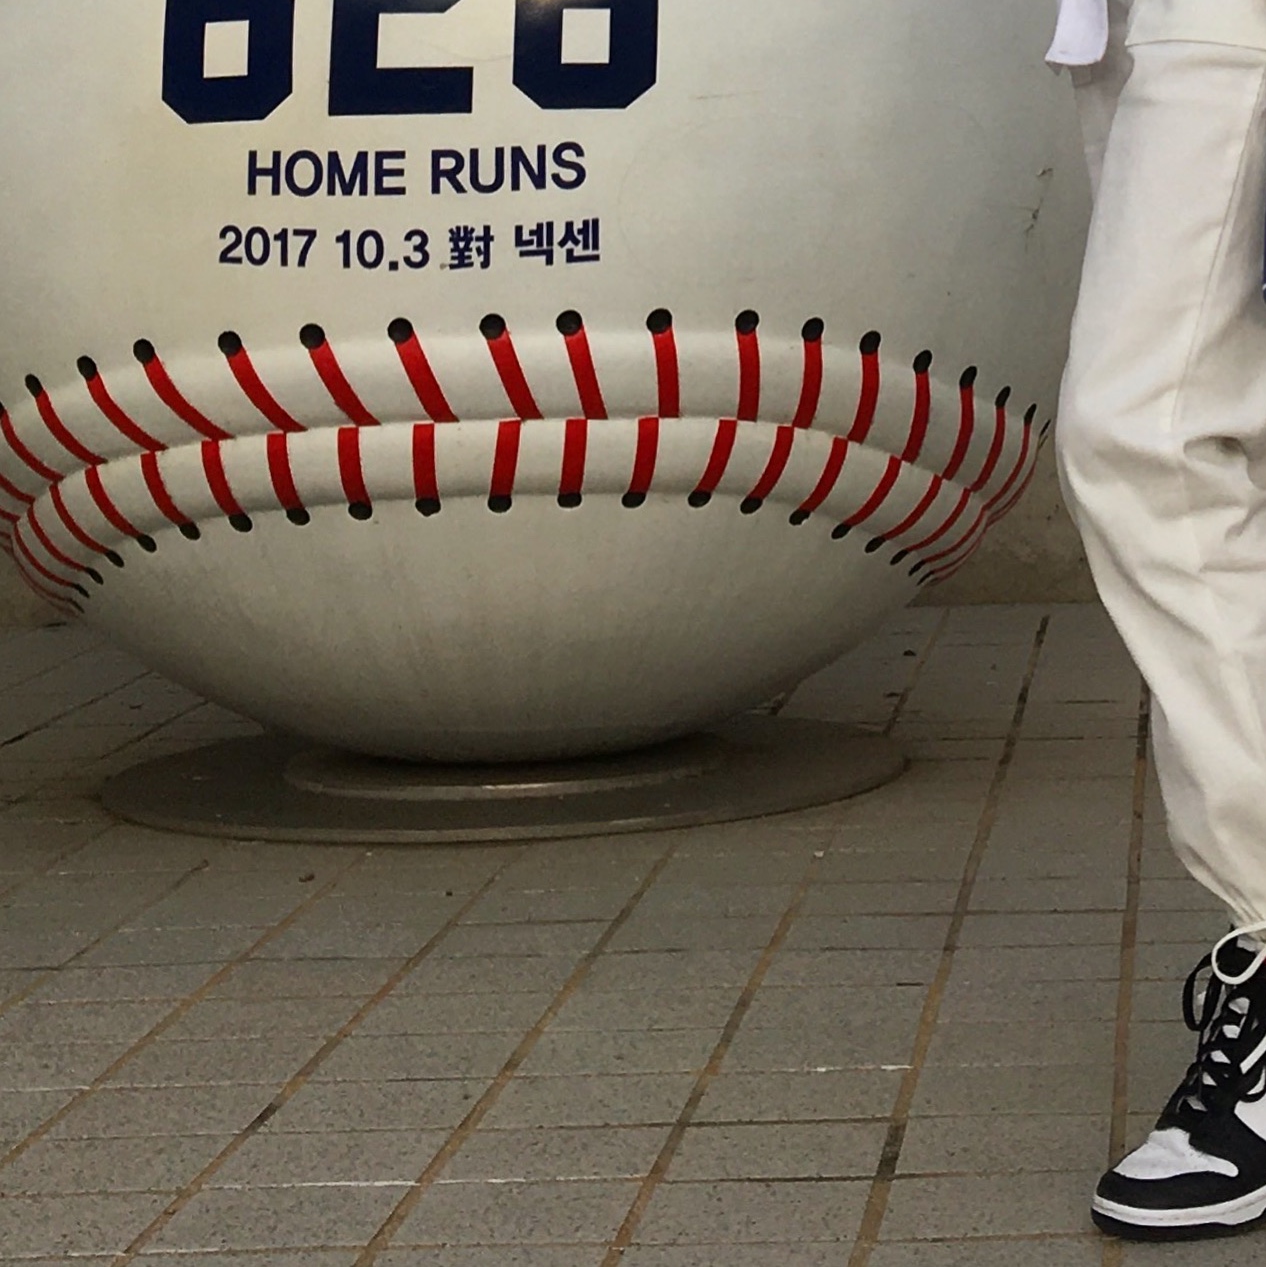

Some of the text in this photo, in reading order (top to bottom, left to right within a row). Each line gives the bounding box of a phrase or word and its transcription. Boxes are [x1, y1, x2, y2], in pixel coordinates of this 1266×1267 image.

[246, 141, 588, 197] HOME RUNS
[217, 216, 601, 272] 2017 10.3 對 넥센
